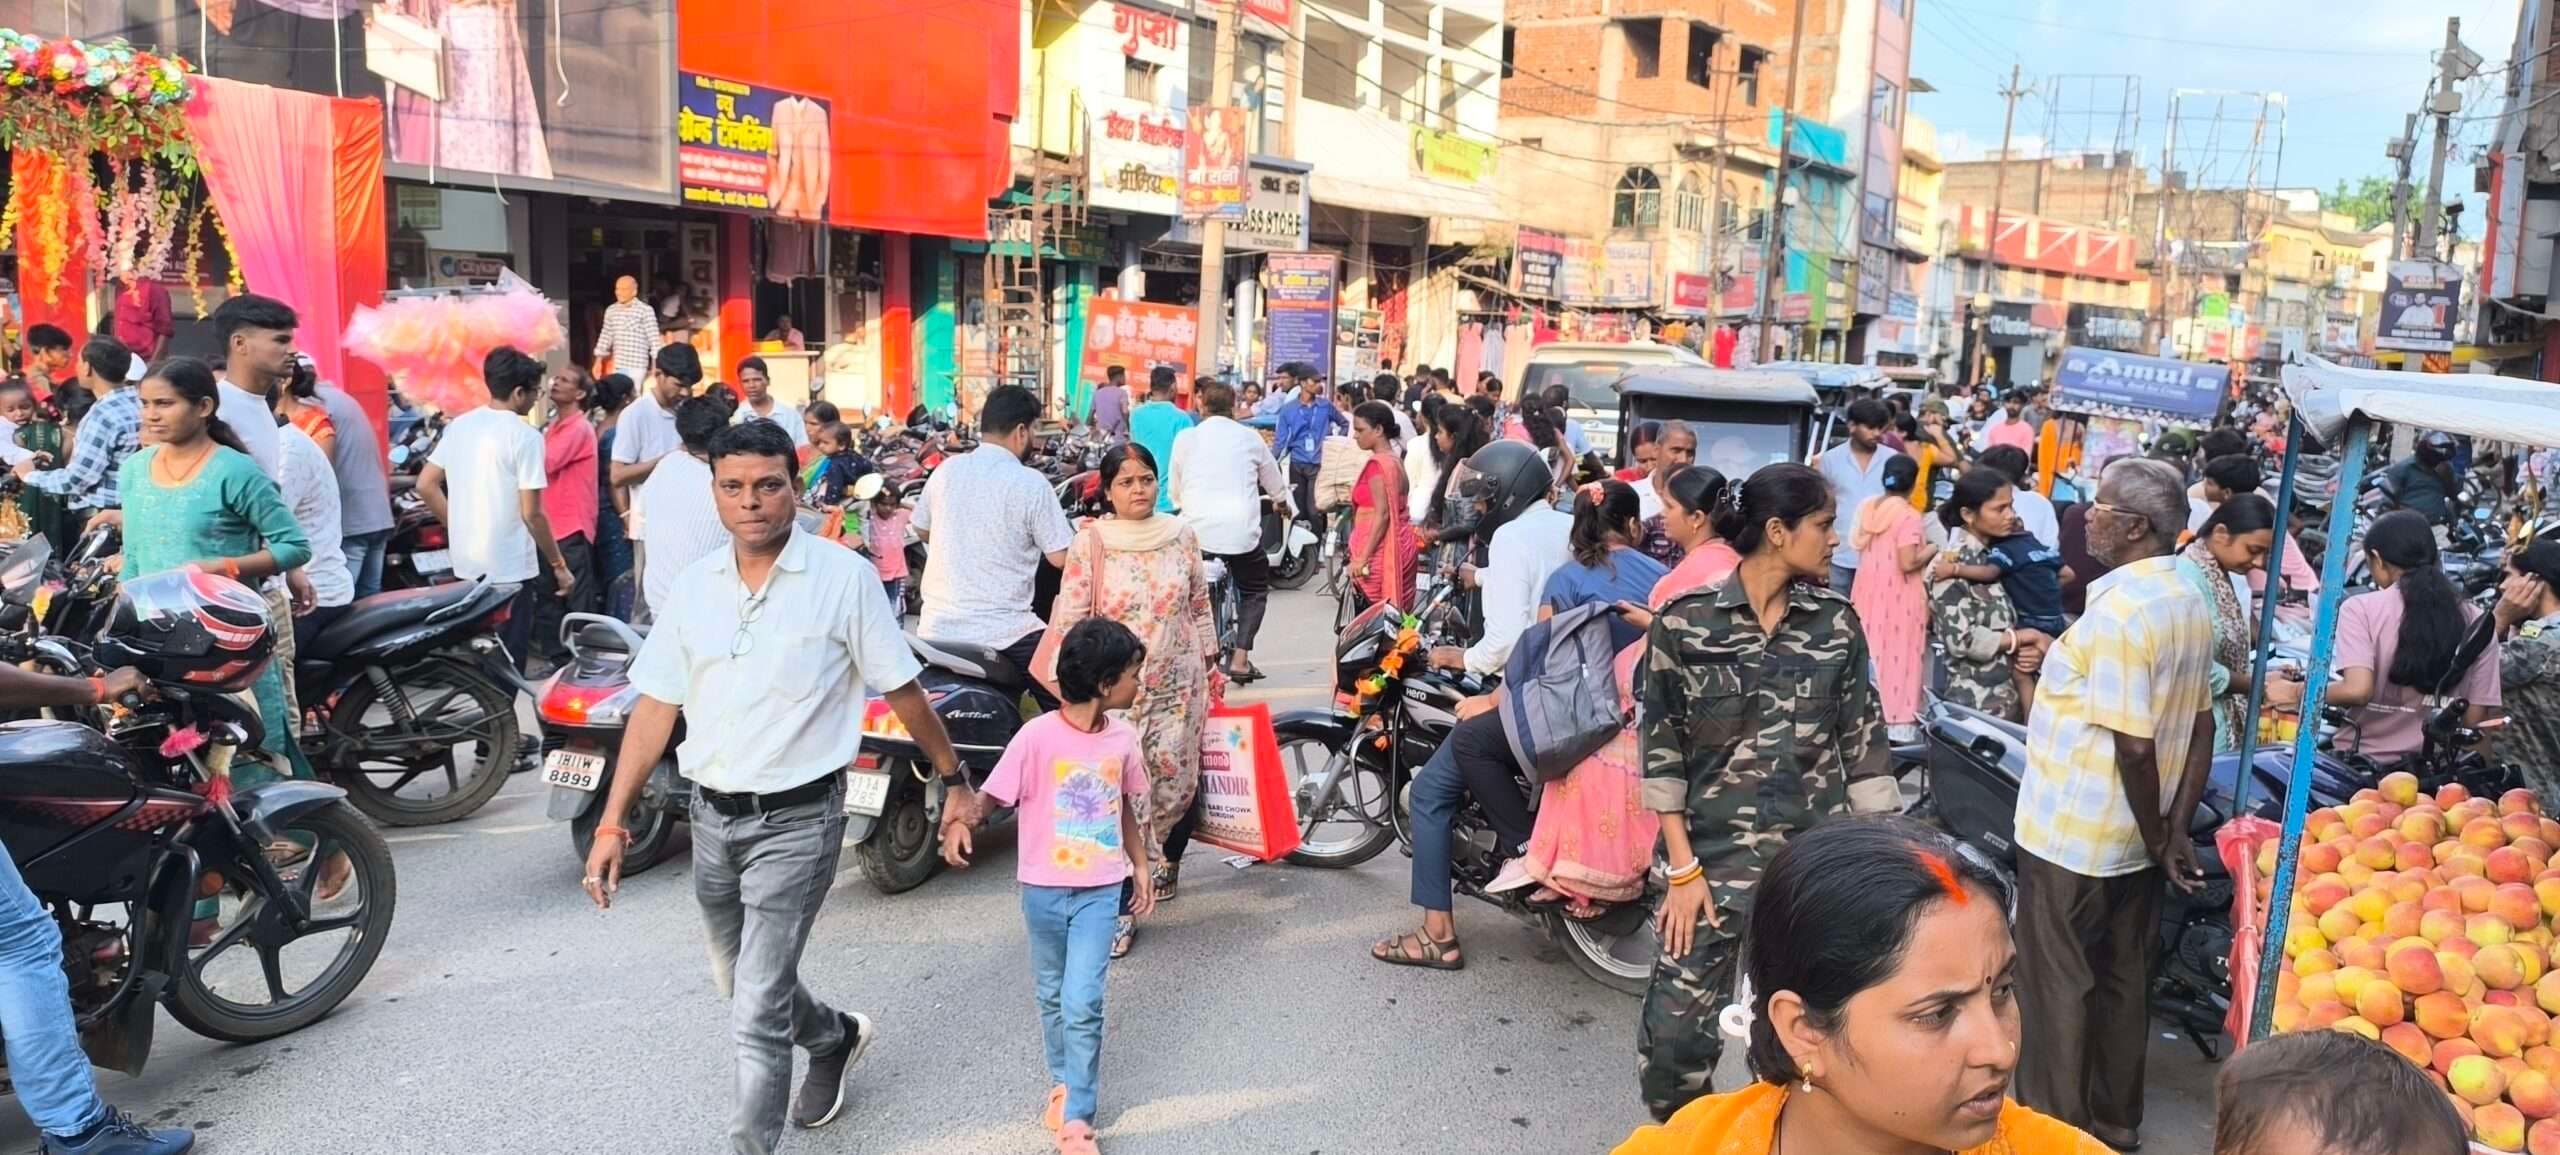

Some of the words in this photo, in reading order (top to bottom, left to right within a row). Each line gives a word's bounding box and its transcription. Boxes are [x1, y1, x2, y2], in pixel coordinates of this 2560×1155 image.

[1113, 3, 1179, 56] गुप्ता
[1266, 210, 1301, 237] STORE
[460, 259, 500, 275] Citykar
[2088, 357, 2193, 386] Amul
[1406, 687, 1427, 701] Hero
[1203, 752, 1229, 767] mond
[549, 769, 592, 787] 8899
